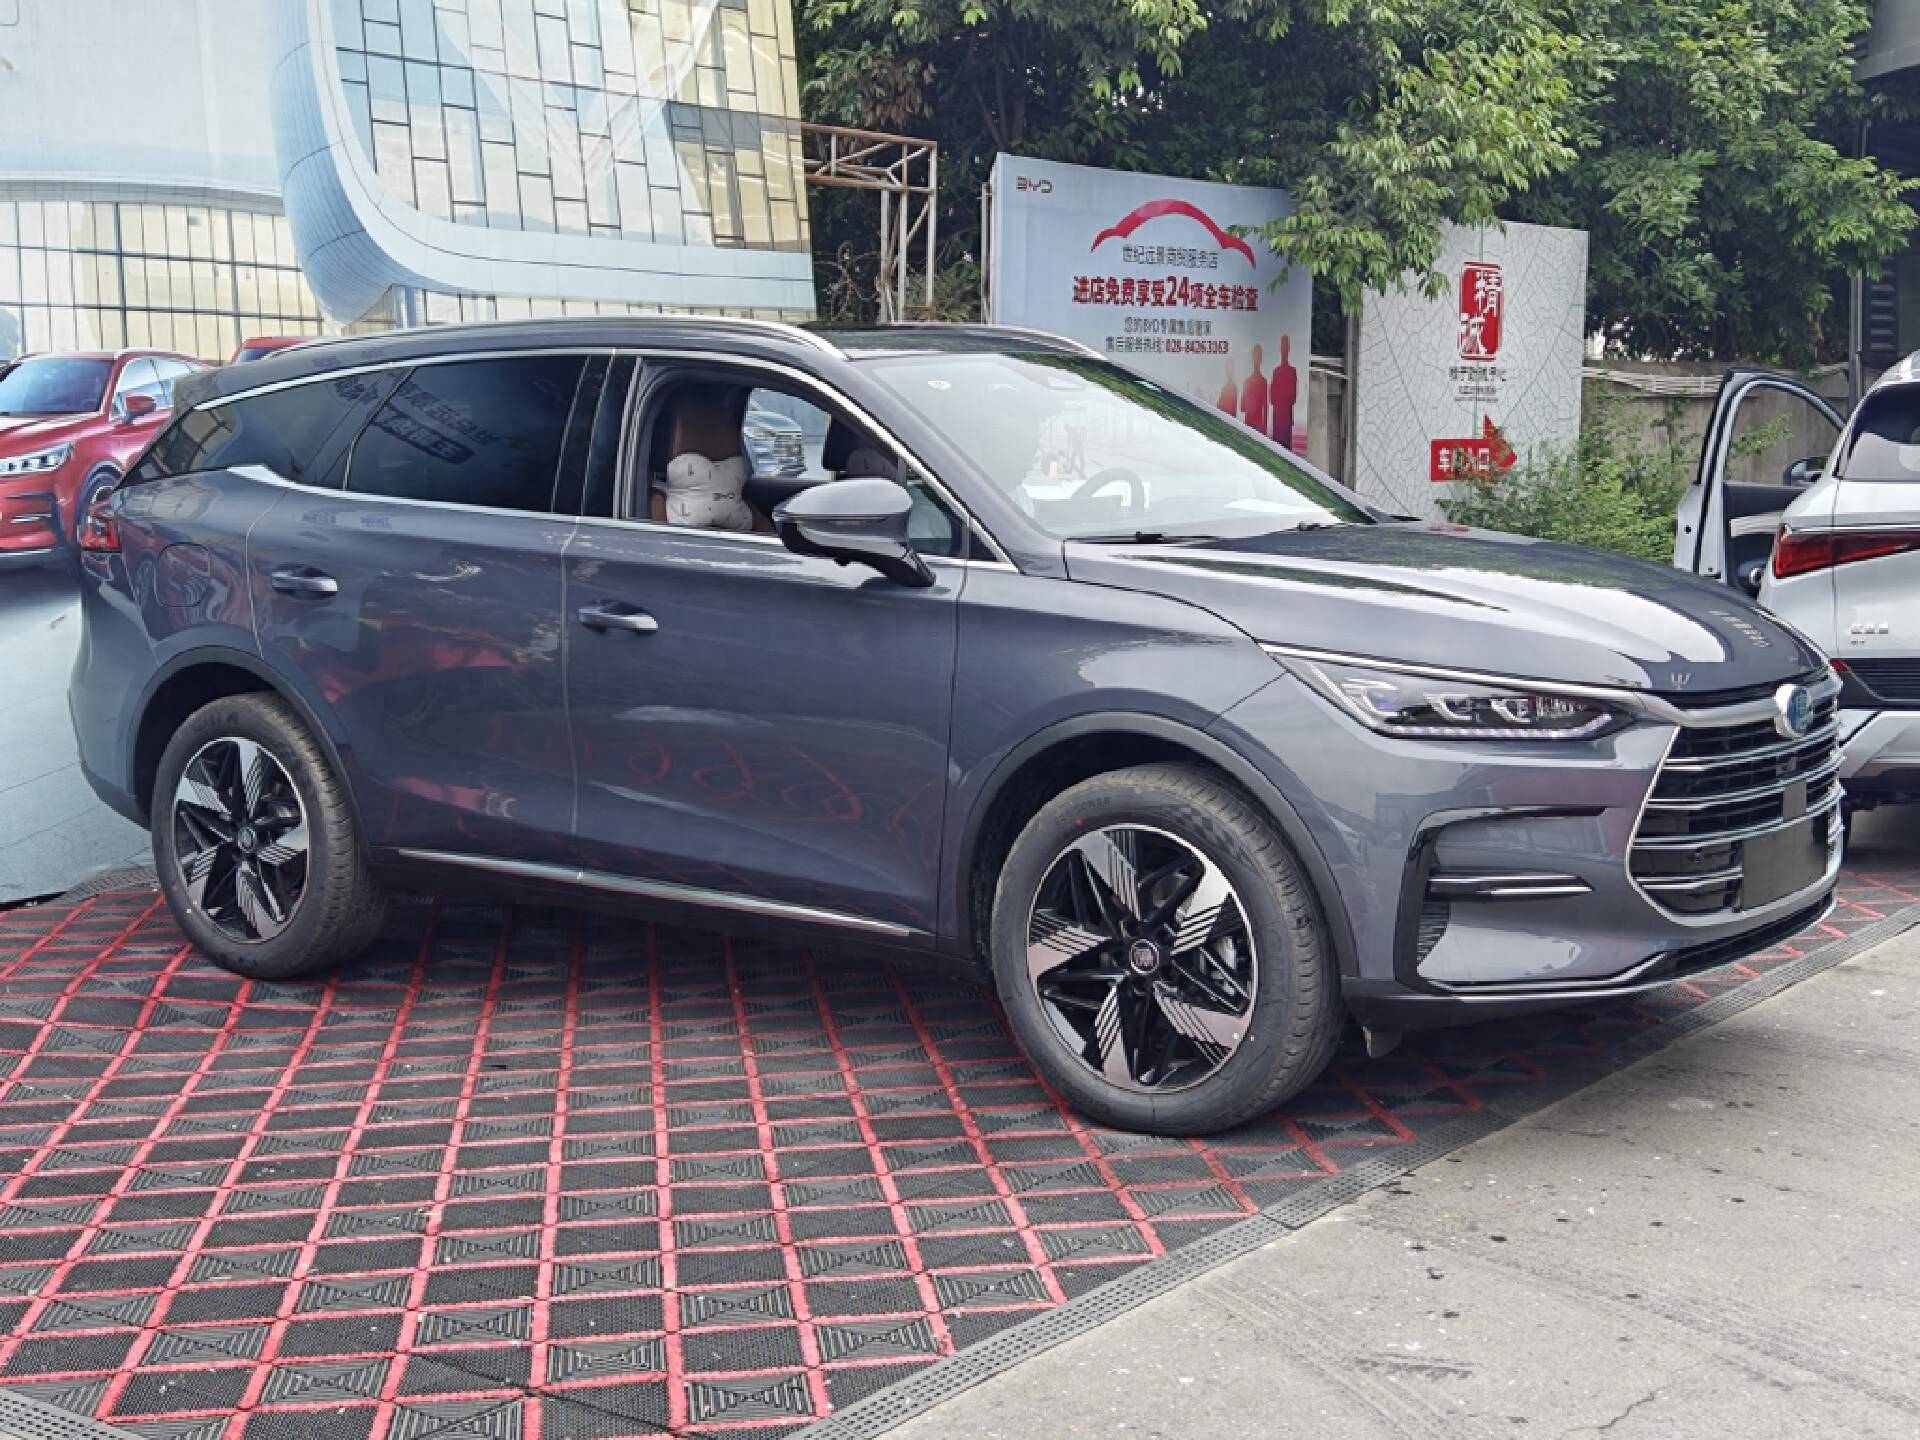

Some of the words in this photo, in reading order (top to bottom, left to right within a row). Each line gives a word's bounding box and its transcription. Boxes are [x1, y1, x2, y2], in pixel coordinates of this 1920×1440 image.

[1072, 275, 1259, 312] 进店免费享受24项全车检查
